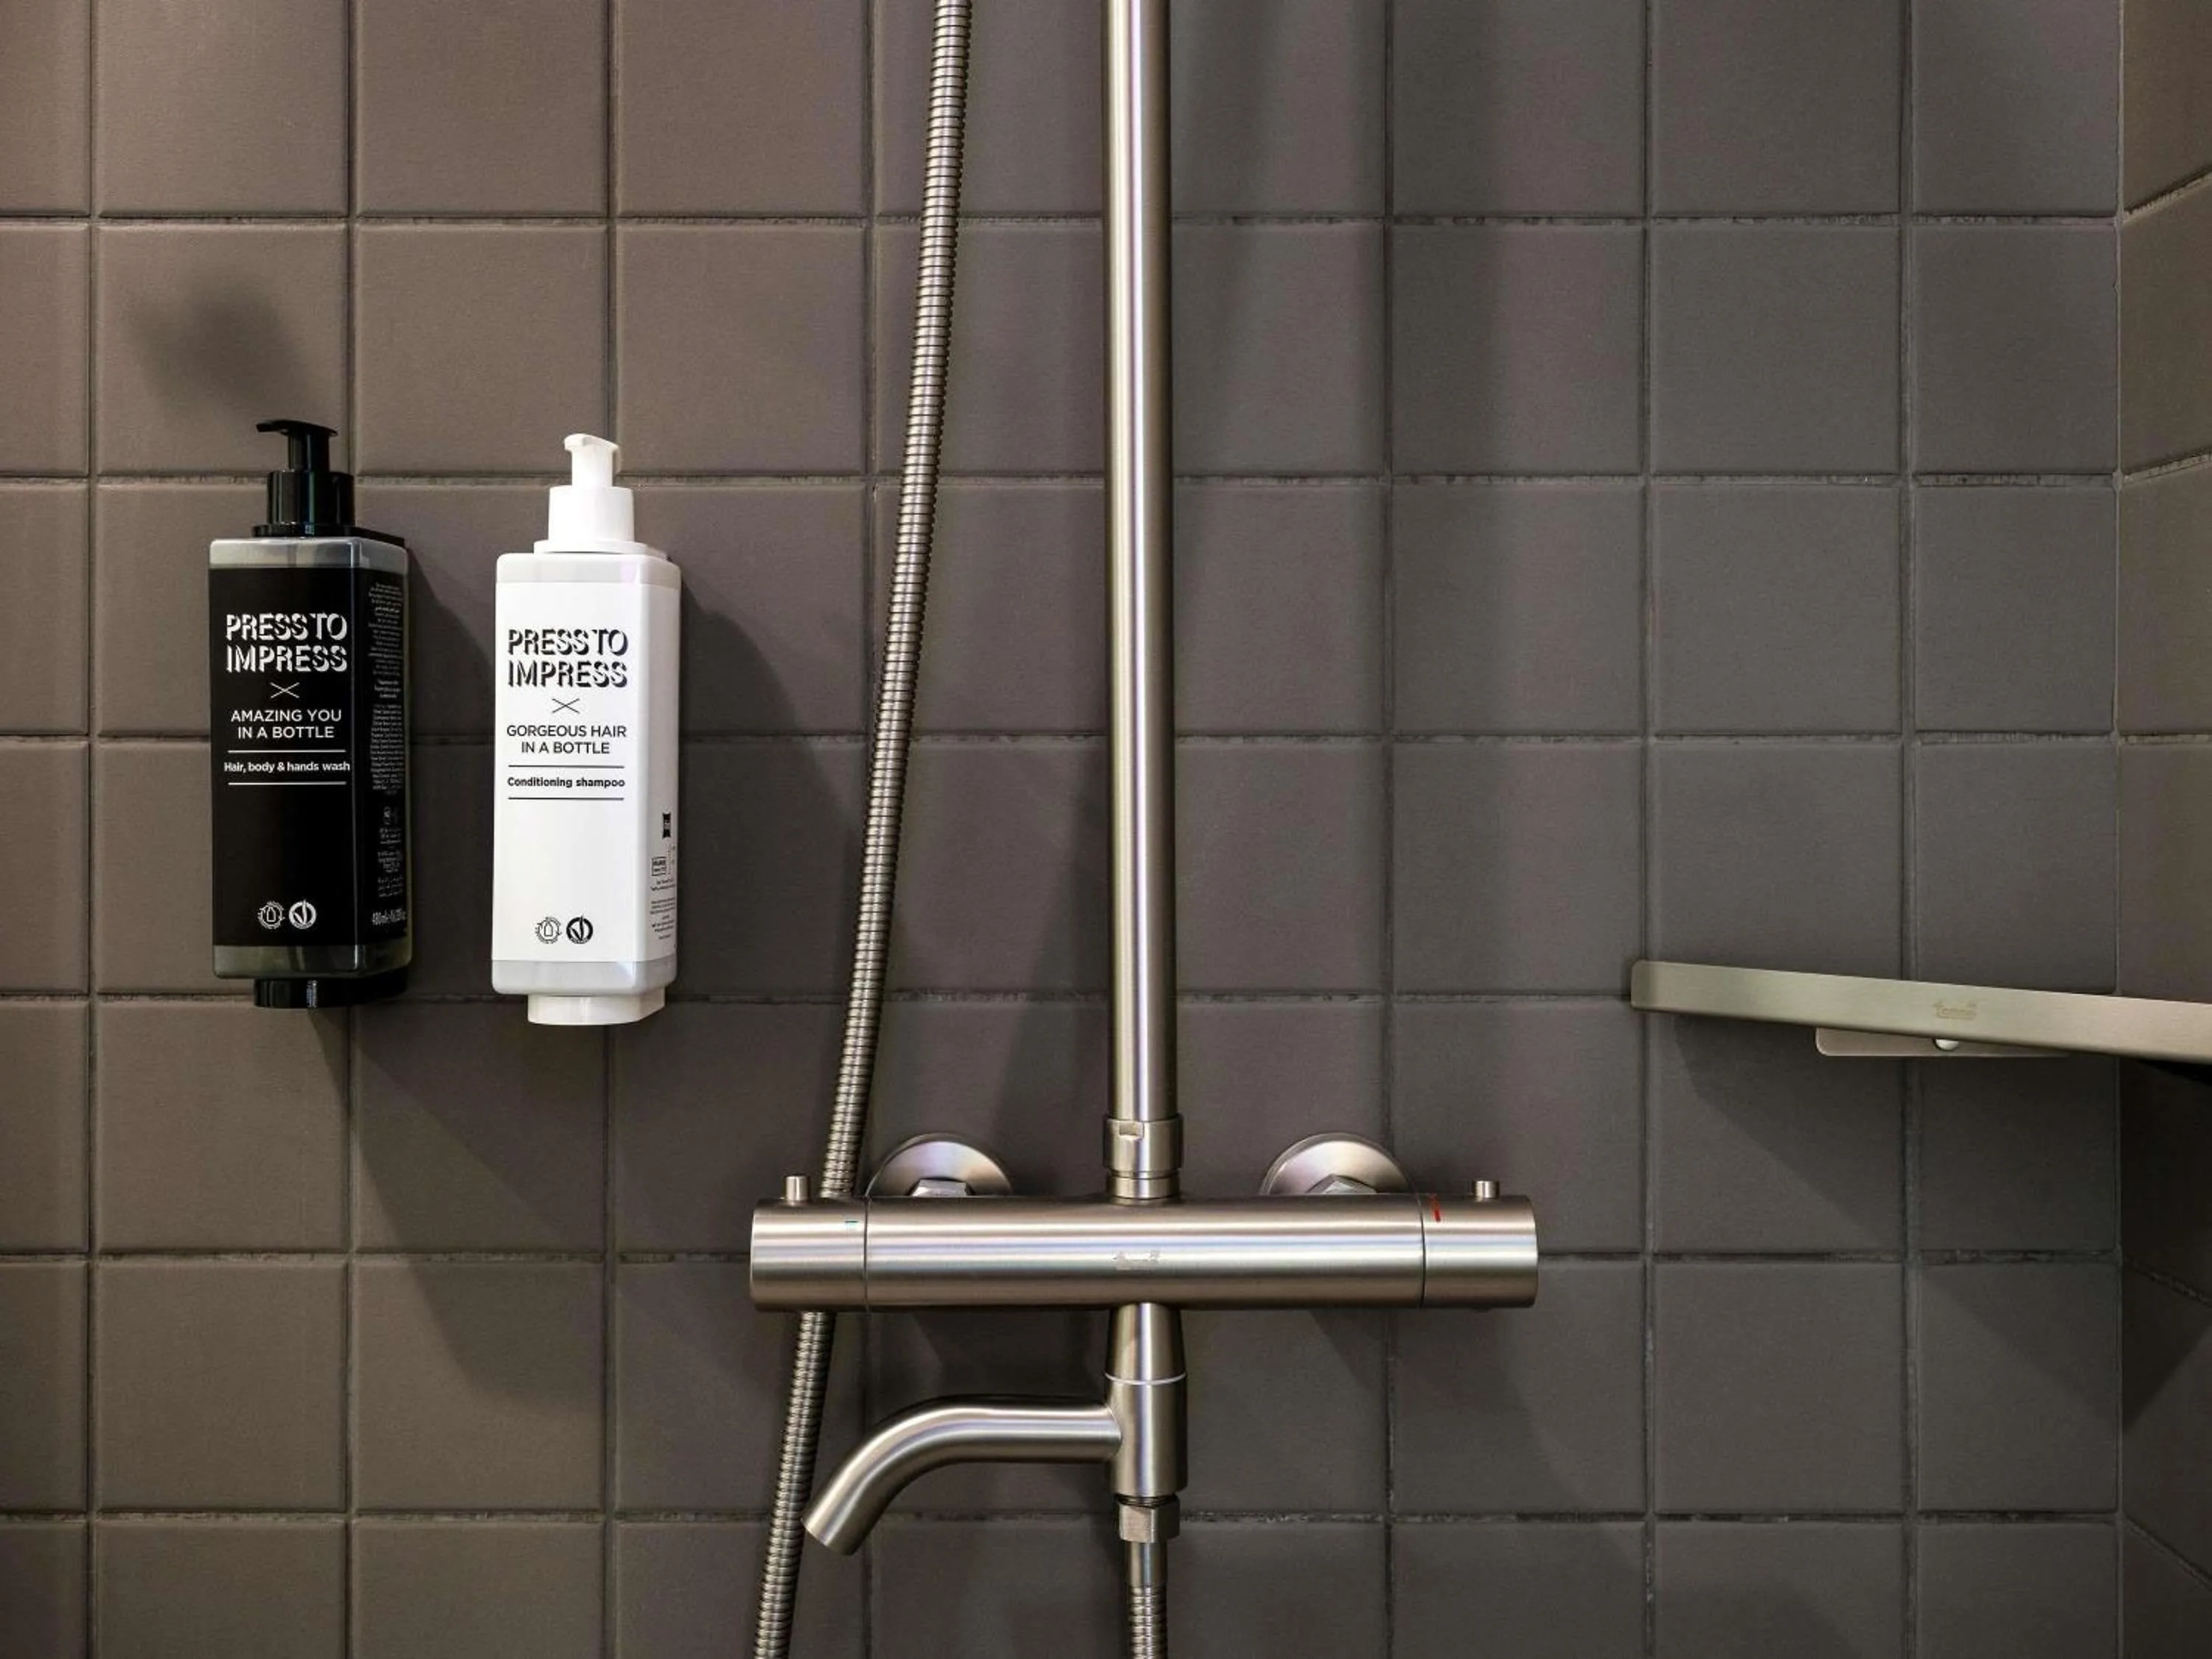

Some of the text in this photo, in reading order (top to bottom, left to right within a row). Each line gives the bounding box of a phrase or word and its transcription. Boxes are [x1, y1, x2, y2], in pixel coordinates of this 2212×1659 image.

[226, 613, 347, 640] PRESS TO
[508, 629, 628, 656] PRESS TO
[226, 644, 347, 672] IMPRESS
[508, 660, 627, 687] IMPRESS
[231, 709, 341, 722] AMAZING YOU
[238, 726, 334, 738] IN A BOTTLE
[507, 725, 626, 737] GORGEOUS HAIR
[521, 742, 610, 754] IN A BOTTLE
[224, 761, 350, 773] Hair, body & hands wash
[507, 777, 625, 787] Conditioning shampoo
